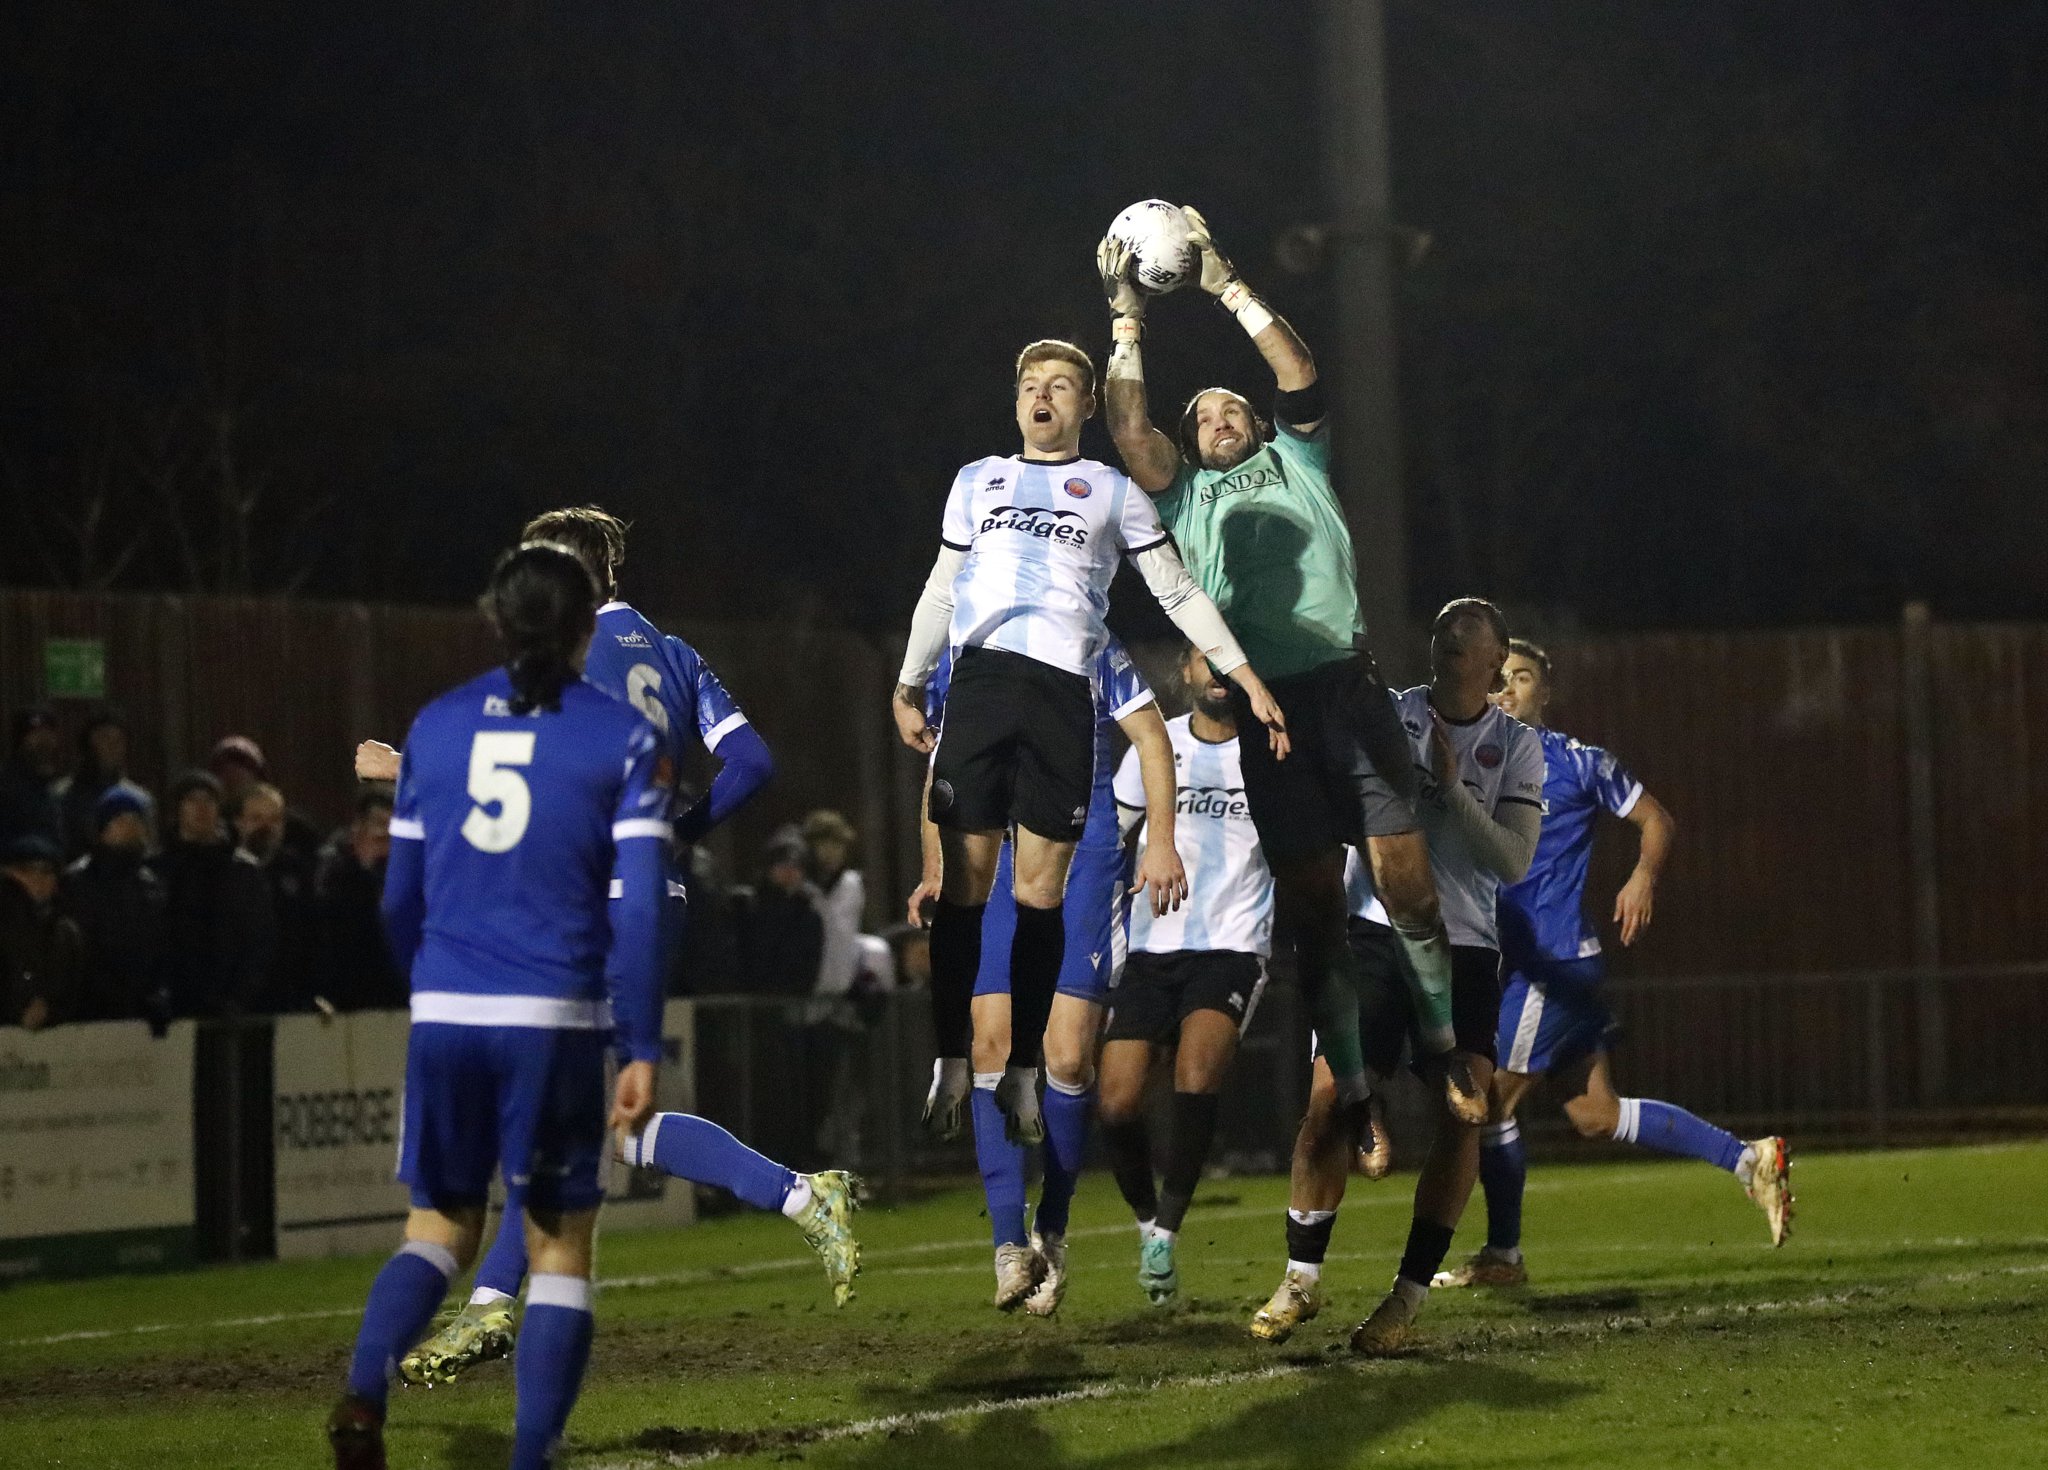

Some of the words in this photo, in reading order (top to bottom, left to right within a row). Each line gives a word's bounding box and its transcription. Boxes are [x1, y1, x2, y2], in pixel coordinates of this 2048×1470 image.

[980, 513, 1089, 545] Bridges
[627, 663, 670, 738] 6
[461, 731, 536, 854] 5
[1176, 793, 1251, 819] ridge
